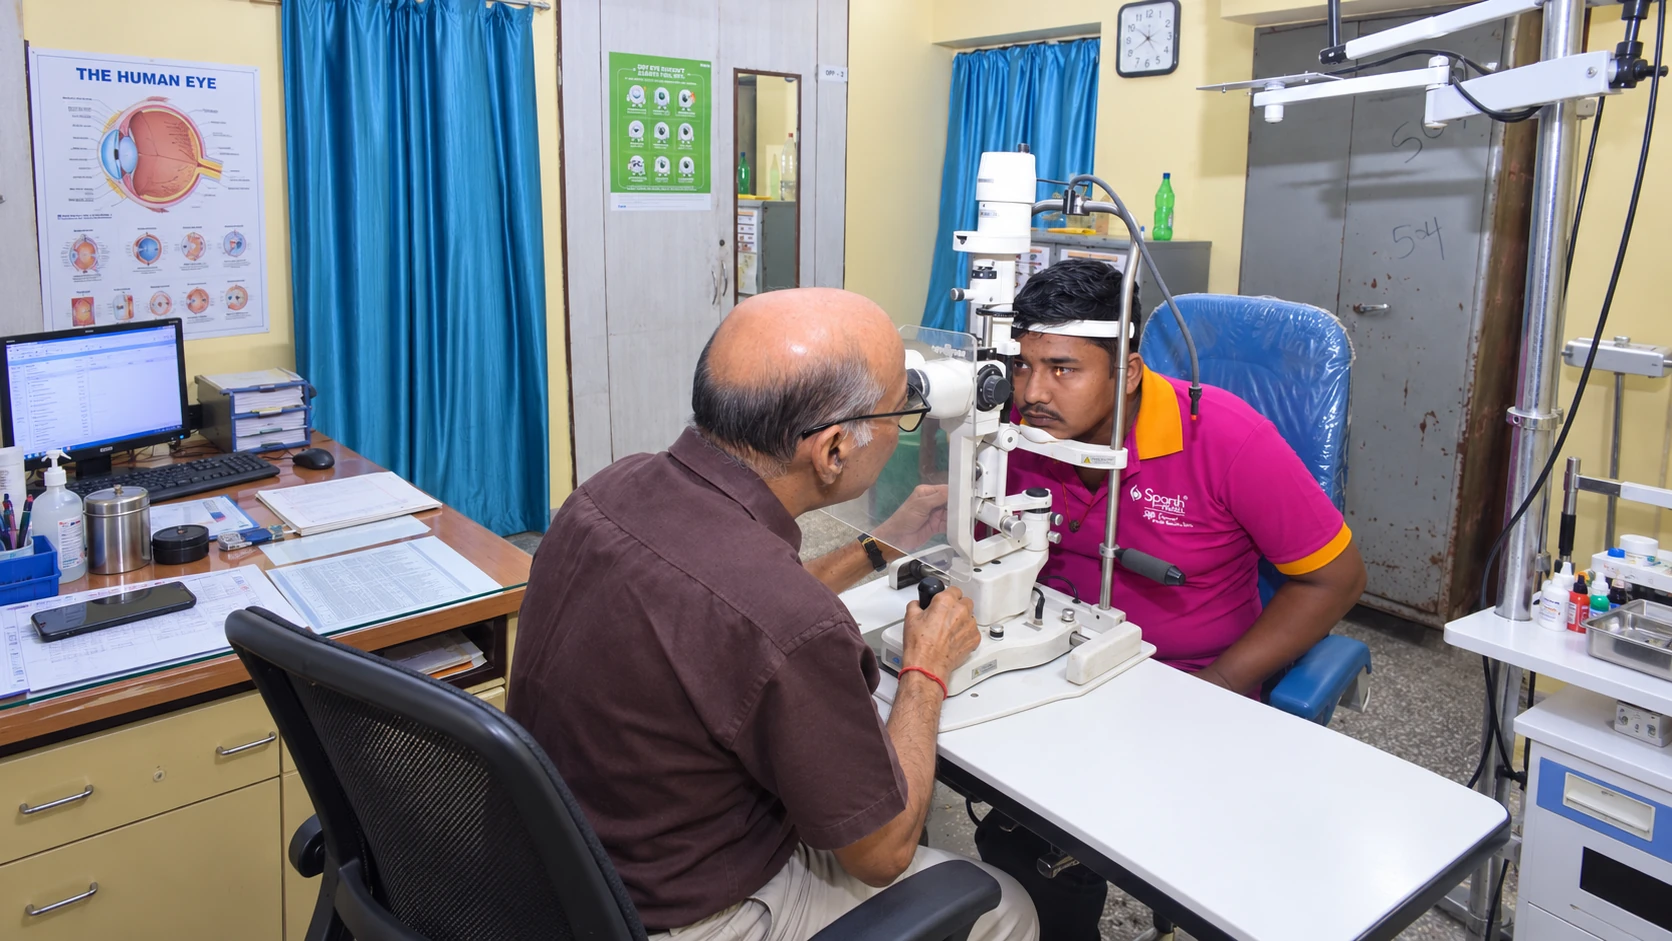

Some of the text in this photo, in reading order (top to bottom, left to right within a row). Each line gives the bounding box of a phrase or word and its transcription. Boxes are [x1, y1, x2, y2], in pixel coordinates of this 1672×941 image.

[1136, 14, 1142, 22] 11
[1146, 9, 1153, 18] 12
[1128, 24, 1136, 32] 10
[1165, 19, 1171, 28] 2
[1167, 32, 1172, 40] 3
[1164, 46, 1169, 54] 4
[1135, 57, 1140, 68] 7
[1144, 59, 1150, 68] 6
[1155, 55, 1161, 64] 5
[76, 67, 217, 90] THE HUMAN EYE
[1391, 216, 1445, 260] 504
